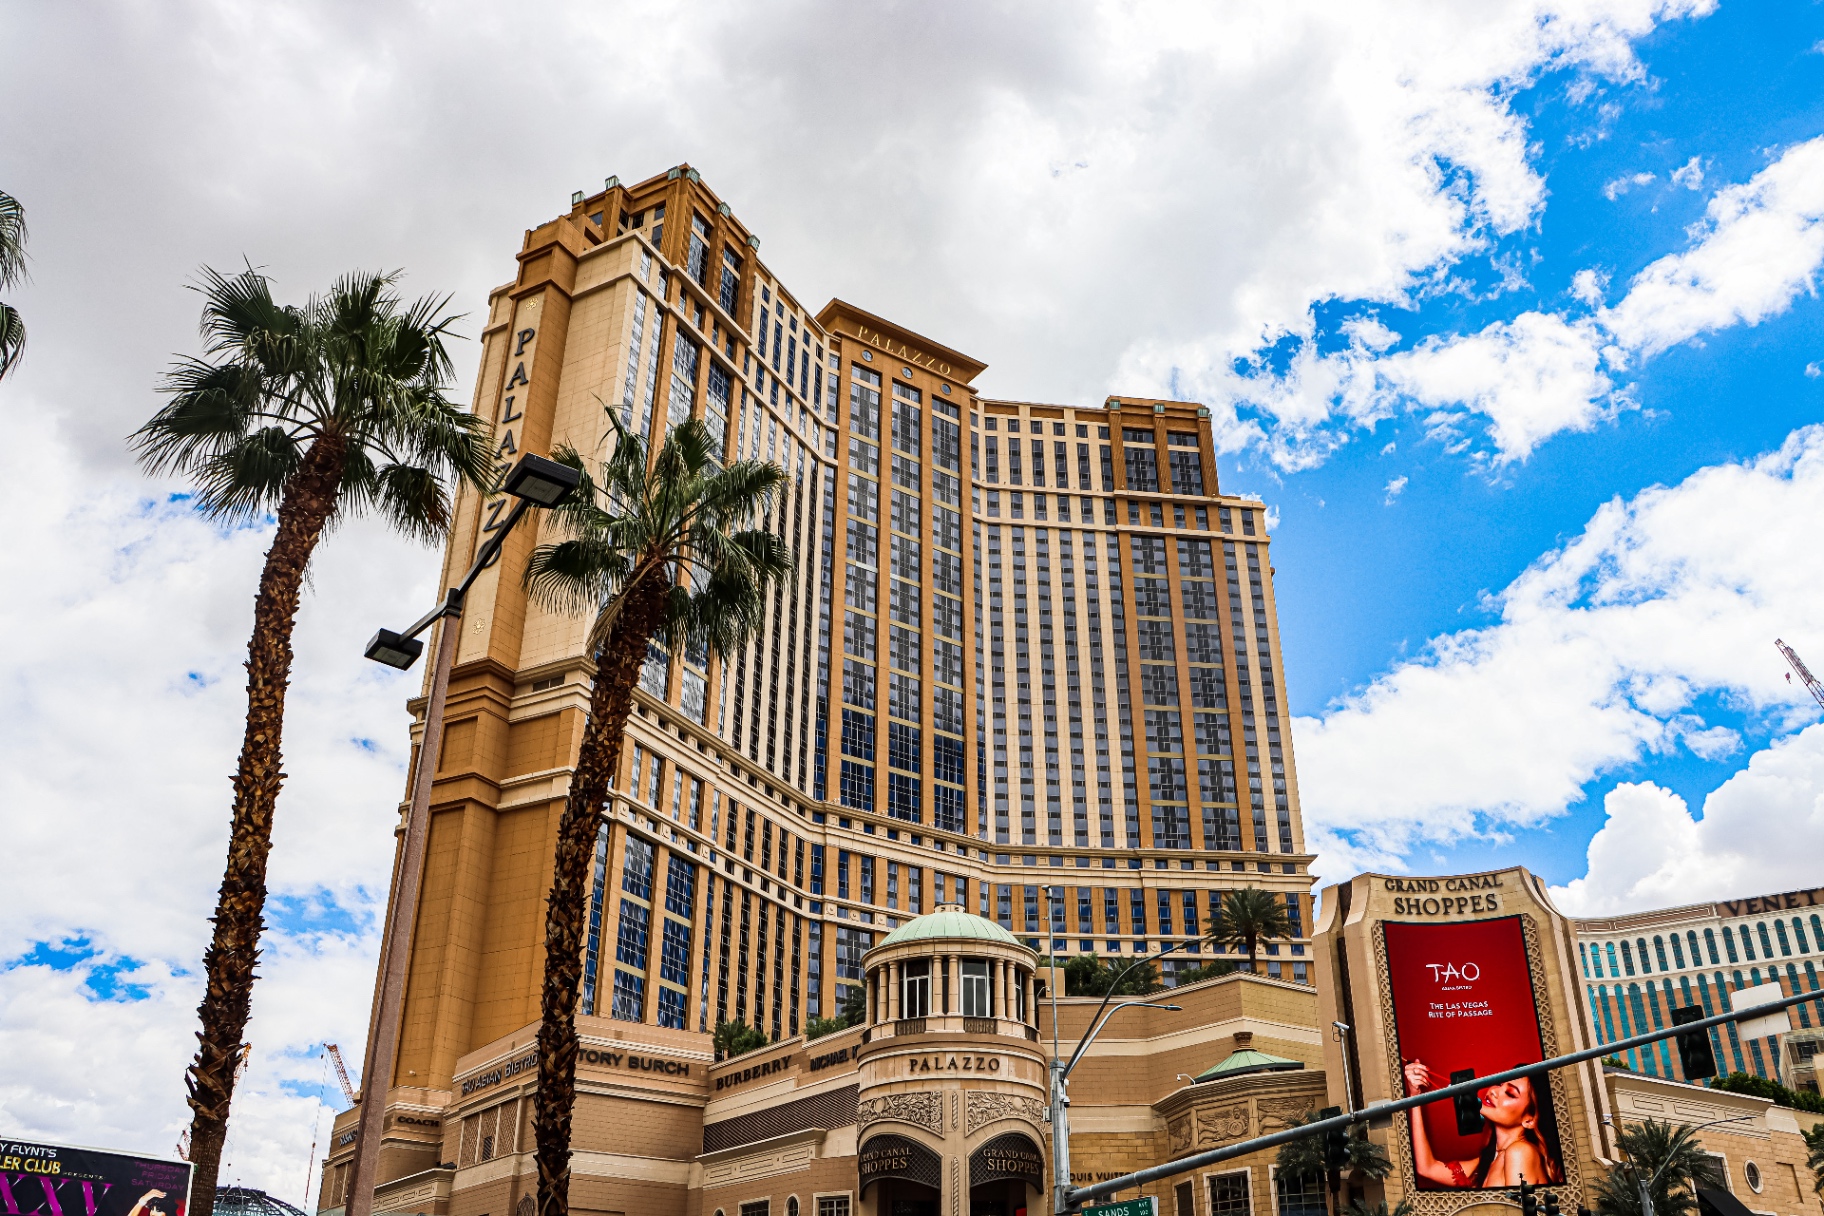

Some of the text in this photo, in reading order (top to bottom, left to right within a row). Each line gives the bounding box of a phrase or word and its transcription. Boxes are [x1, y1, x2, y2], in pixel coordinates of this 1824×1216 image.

[858, 325, 951, 375] PALAZZO
[476, 327, 535, 569] PALAZZO
[1384, 874, 1504, 893] GRAND CANAL
[1394, 893, 1498, 915] SHOPPES
[1723, 887, 1819, 917] VENET
[1425, 961, 1481, 984] TAO
[1429, 1001, 1489, 1010] THE LAS VEGAS
[1457, 1009, 1493, 1018] PASSAGE
[578, 1048, 690, 1076] TORY BURCH
[810, 1050, 850, 1073] MICHAEL
[909, 1056, 1000, 1072] PALAZZO
[475, 1069, 502, 1090] ASIAN
[504, 1052, 539, 1078] BISTRO
[715, 1055, 792, 1091] BURBERRY
[397, 1115, 440, 1127] COACH
[881, 1147, 912, 1158] CANAL
[983, 1148, 1019, 1159] GRAND
[24, 1158, 61, 1174] CLUB
[134, 1161, 187, 1174] THURSDAY
[862, 1157, 908, 1174] SHOPPES
[987, 1158, 1040, 1175] SHOPPES
[141, 1171, 177, 1181] FRIDAY
[1069, 1172, 1093, 1182] OUIS
[131, 1179, 185, 1191] SATURDAY
[1097, 1206, 1130, 1216] SANDS
